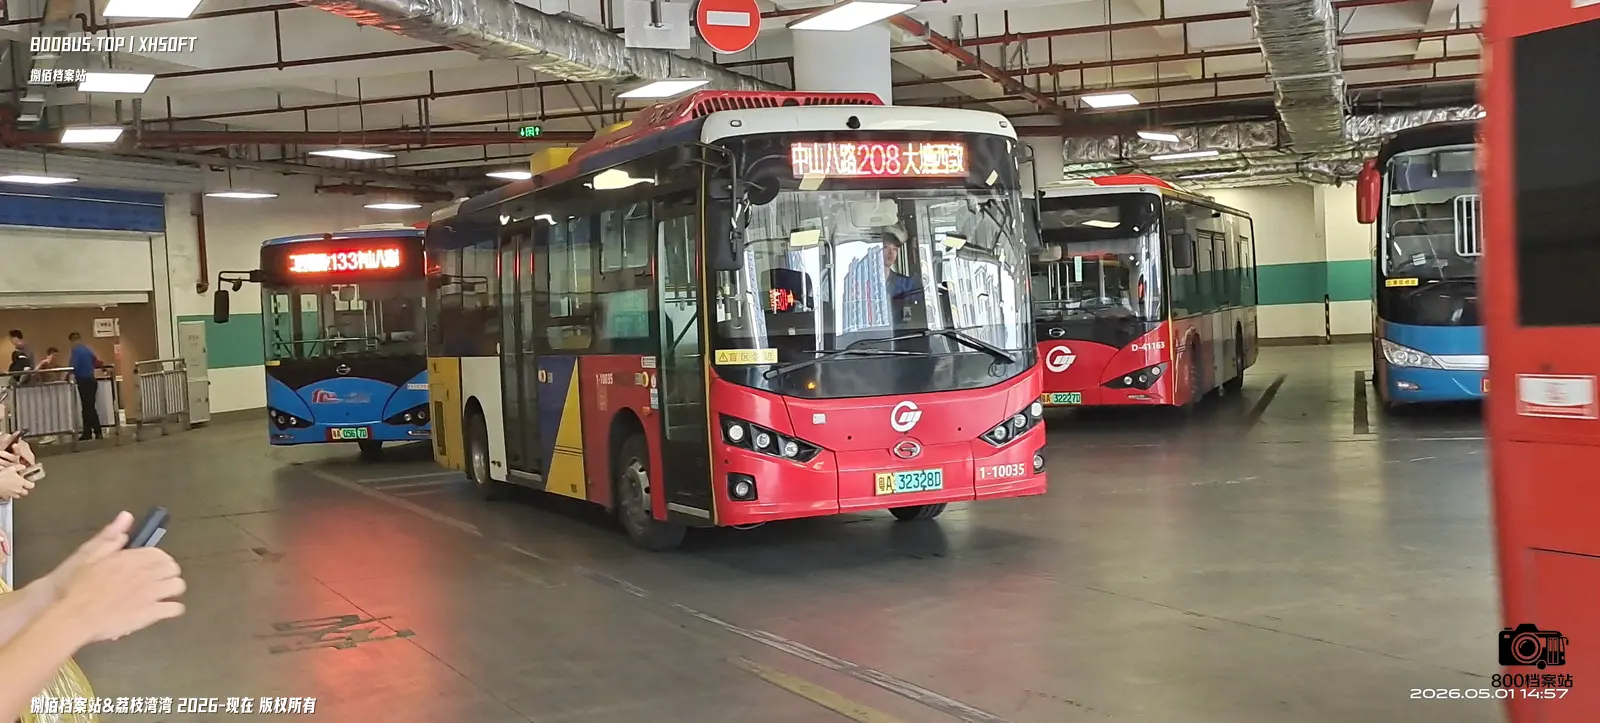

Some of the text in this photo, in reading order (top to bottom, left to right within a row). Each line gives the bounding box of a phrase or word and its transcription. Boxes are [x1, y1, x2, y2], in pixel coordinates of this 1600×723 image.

[791, 142, 857, 176] 中山八路
[857, 144, 901, 175] 208
[330, 252, 359, 271] 133
[1131, 341, 1166, 352] D-41163
[595, 373, 613, 385] 1-10035
[979, 463, 1025, 479] 1-10035
[898, 471, 942, 490] 32328D
